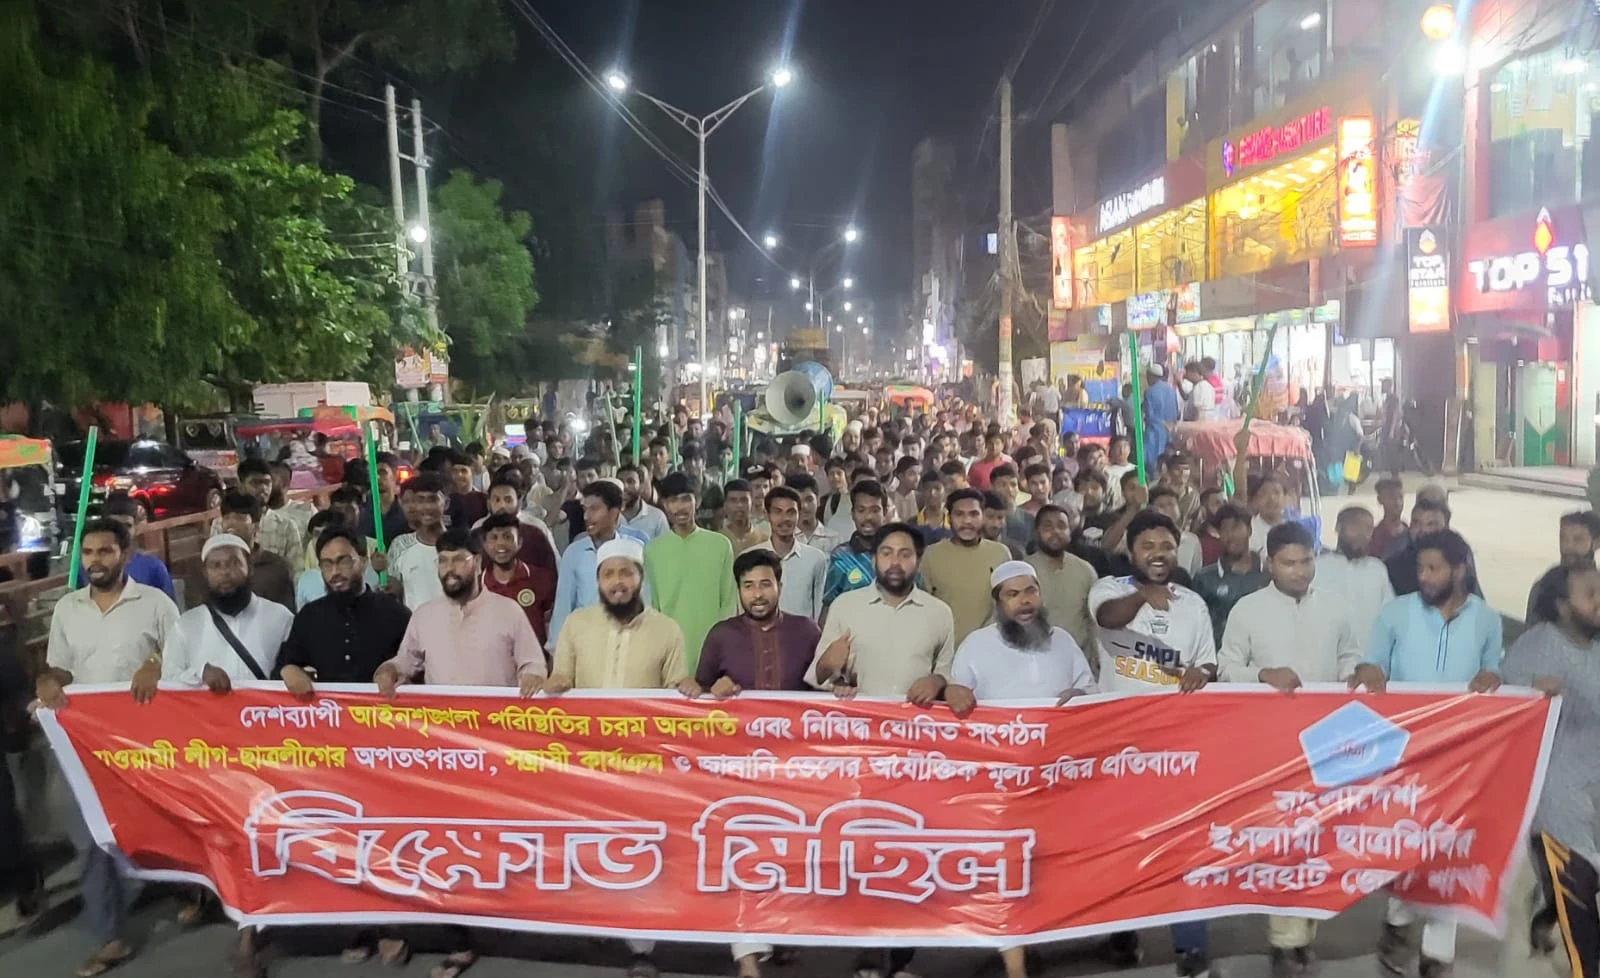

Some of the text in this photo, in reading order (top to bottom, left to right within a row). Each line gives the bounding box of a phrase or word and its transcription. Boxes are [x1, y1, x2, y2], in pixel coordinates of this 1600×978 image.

[1468, 252, 1540, 292] TOP
[240, 699, 1049, 748] দেশব্যাপী আইনশৃঙ্খলা পরিস্থিতির চরম অবনতি এবং নিষিদ্ধ ঘোষিত সংগঠন
[184, 738, 347, 772] লীগ-ছাত্রলীগের
[353, 745, 497, 777] অপতৎপরতা,
[504, 742, 572, 774] সন্ত্রাসী
[577, 747, 664, 774] কার্যক্রম
[672, 755, 692, 773] ও
[696, 748, 779, 780] জ্বালানি
[785, 756, 863, 780] তেলের
[867, 749, 980, 782] অযৌক্তিক
[985, 762, 1034, 792] মূল্য
[1040, 755, 1097, 788] বৃদ্ধির
[1100, 746, 1200, 777] প্রতিবাদে
[246, 790, 1036, 904] বিক্ষোভ মিছিল
[1208, 816, 1477, 862] ইসলামী ছাত্রশিবির
